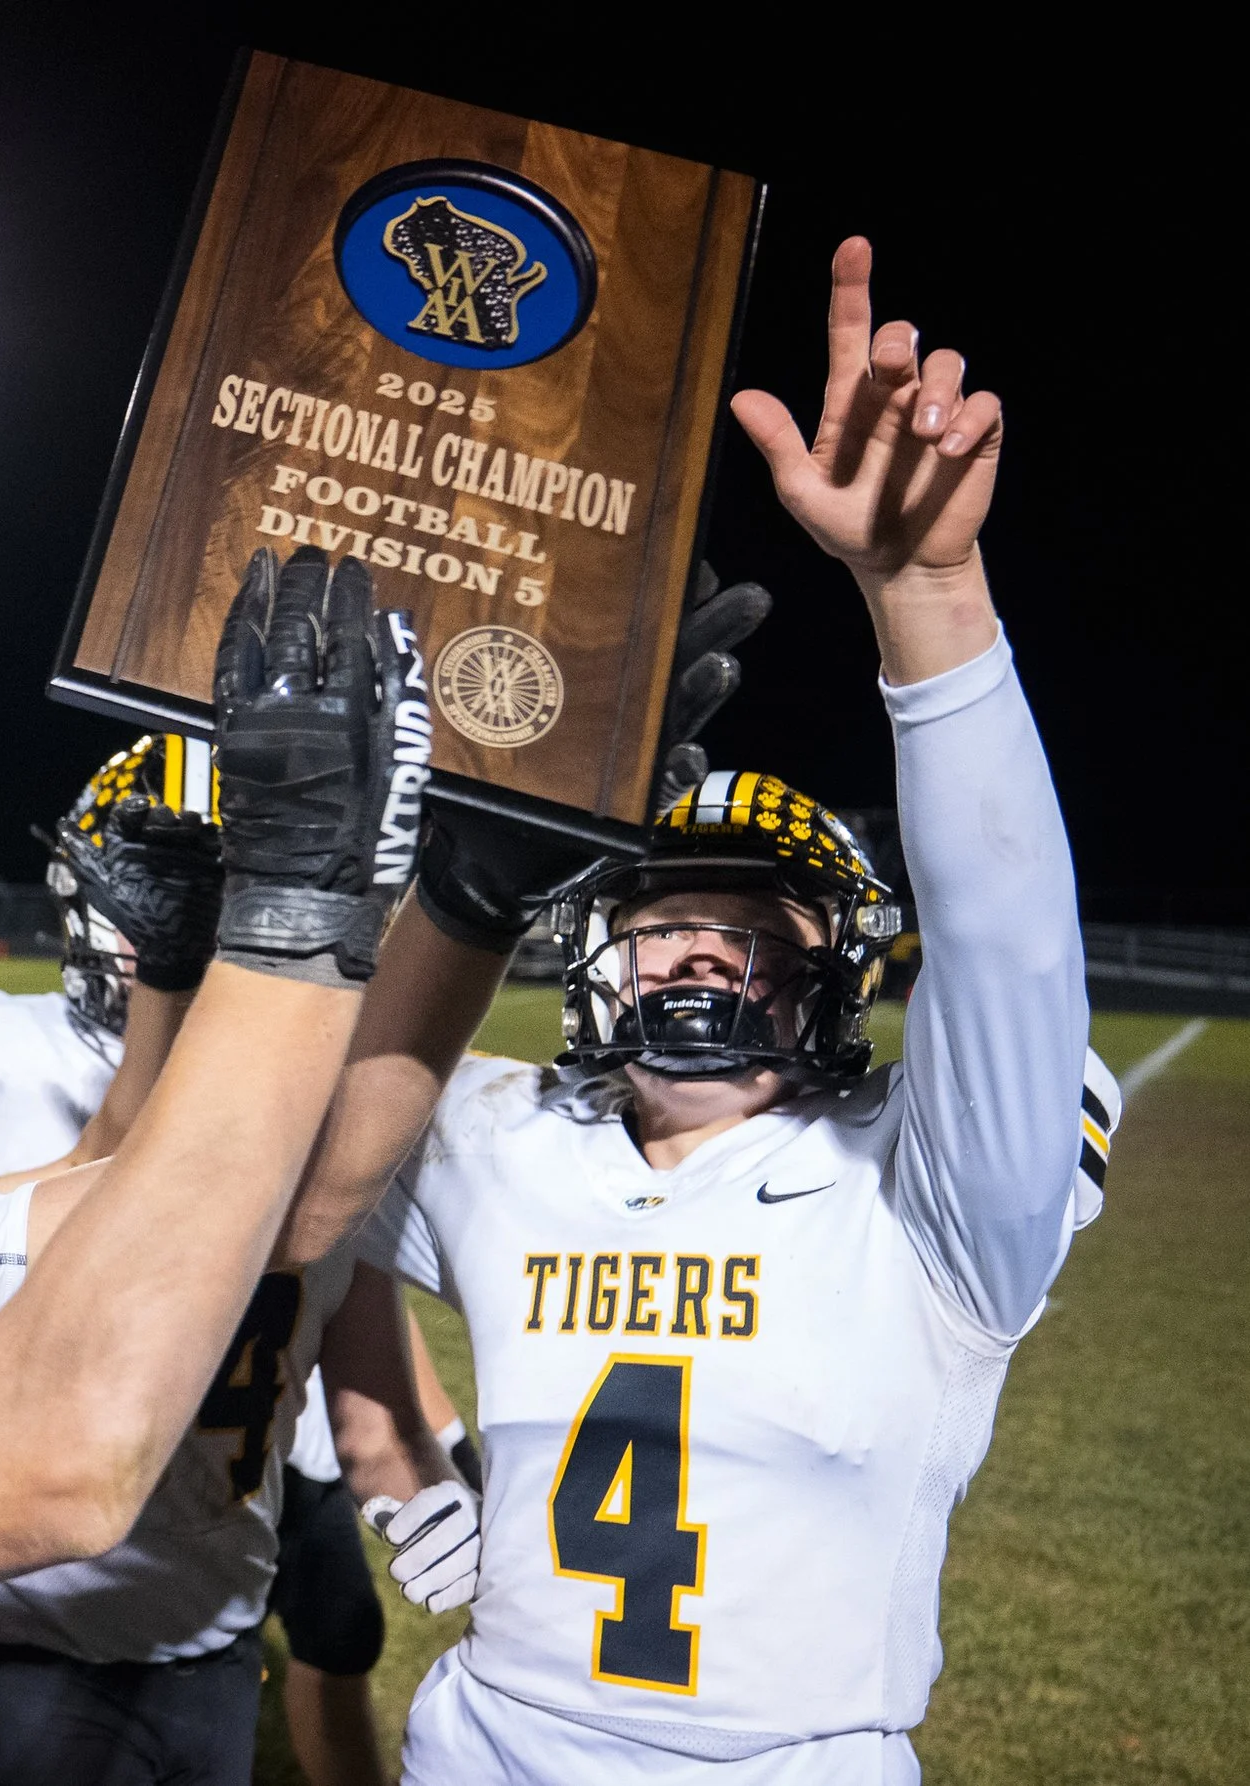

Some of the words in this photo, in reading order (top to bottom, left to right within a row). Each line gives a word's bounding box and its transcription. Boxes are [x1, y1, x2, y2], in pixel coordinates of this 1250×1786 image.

[375, 371, 497, 423] 2025
[211, 373, 424, 479] SECTIONAL
[431, 432, 637, 535] CHAMPION
[256, 505, 504, 597] DIVISION
[514, 577, 546, 607] 5
[270, 464, 548, 564] FOOTBALL
[663, 998, 712, 1011] Riddell
[522, 1251, 761, 1341] TIGERS
[546, 1351, 708, 1697] 4
